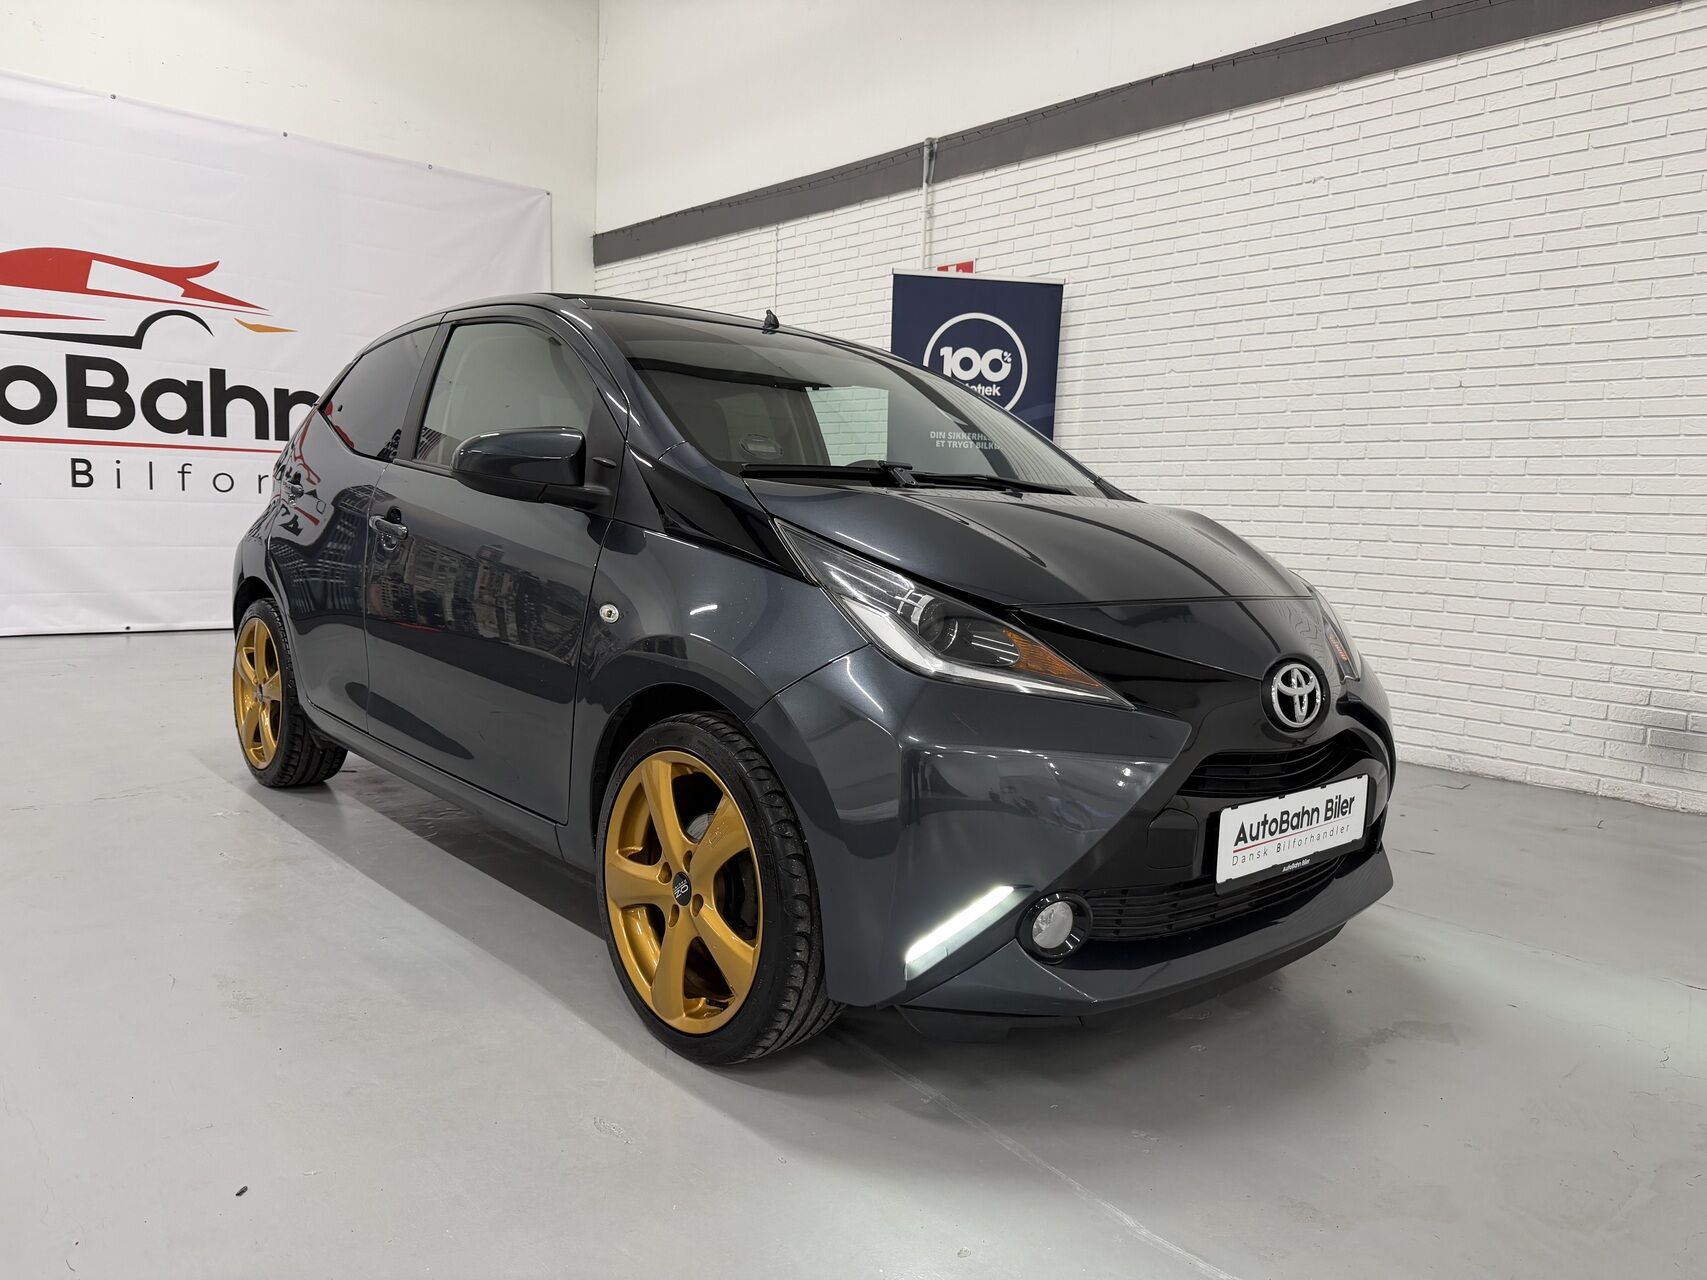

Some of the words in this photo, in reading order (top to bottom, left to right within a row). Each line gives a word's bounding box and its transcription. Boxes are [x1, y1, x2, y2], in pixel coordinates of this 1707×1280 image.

[930, 431, 946, 439] DIN
[936, 440, 945, 448] ET
[947, 440, 974, 449] TRYGT
[1234, 805, 1320, 847] AutoBahn
[1324, 794, 1355, 822] Biler
[1232, 847, 1268, 866] Dansk
[1276, 824, 1350, 853] Bilforhandler
